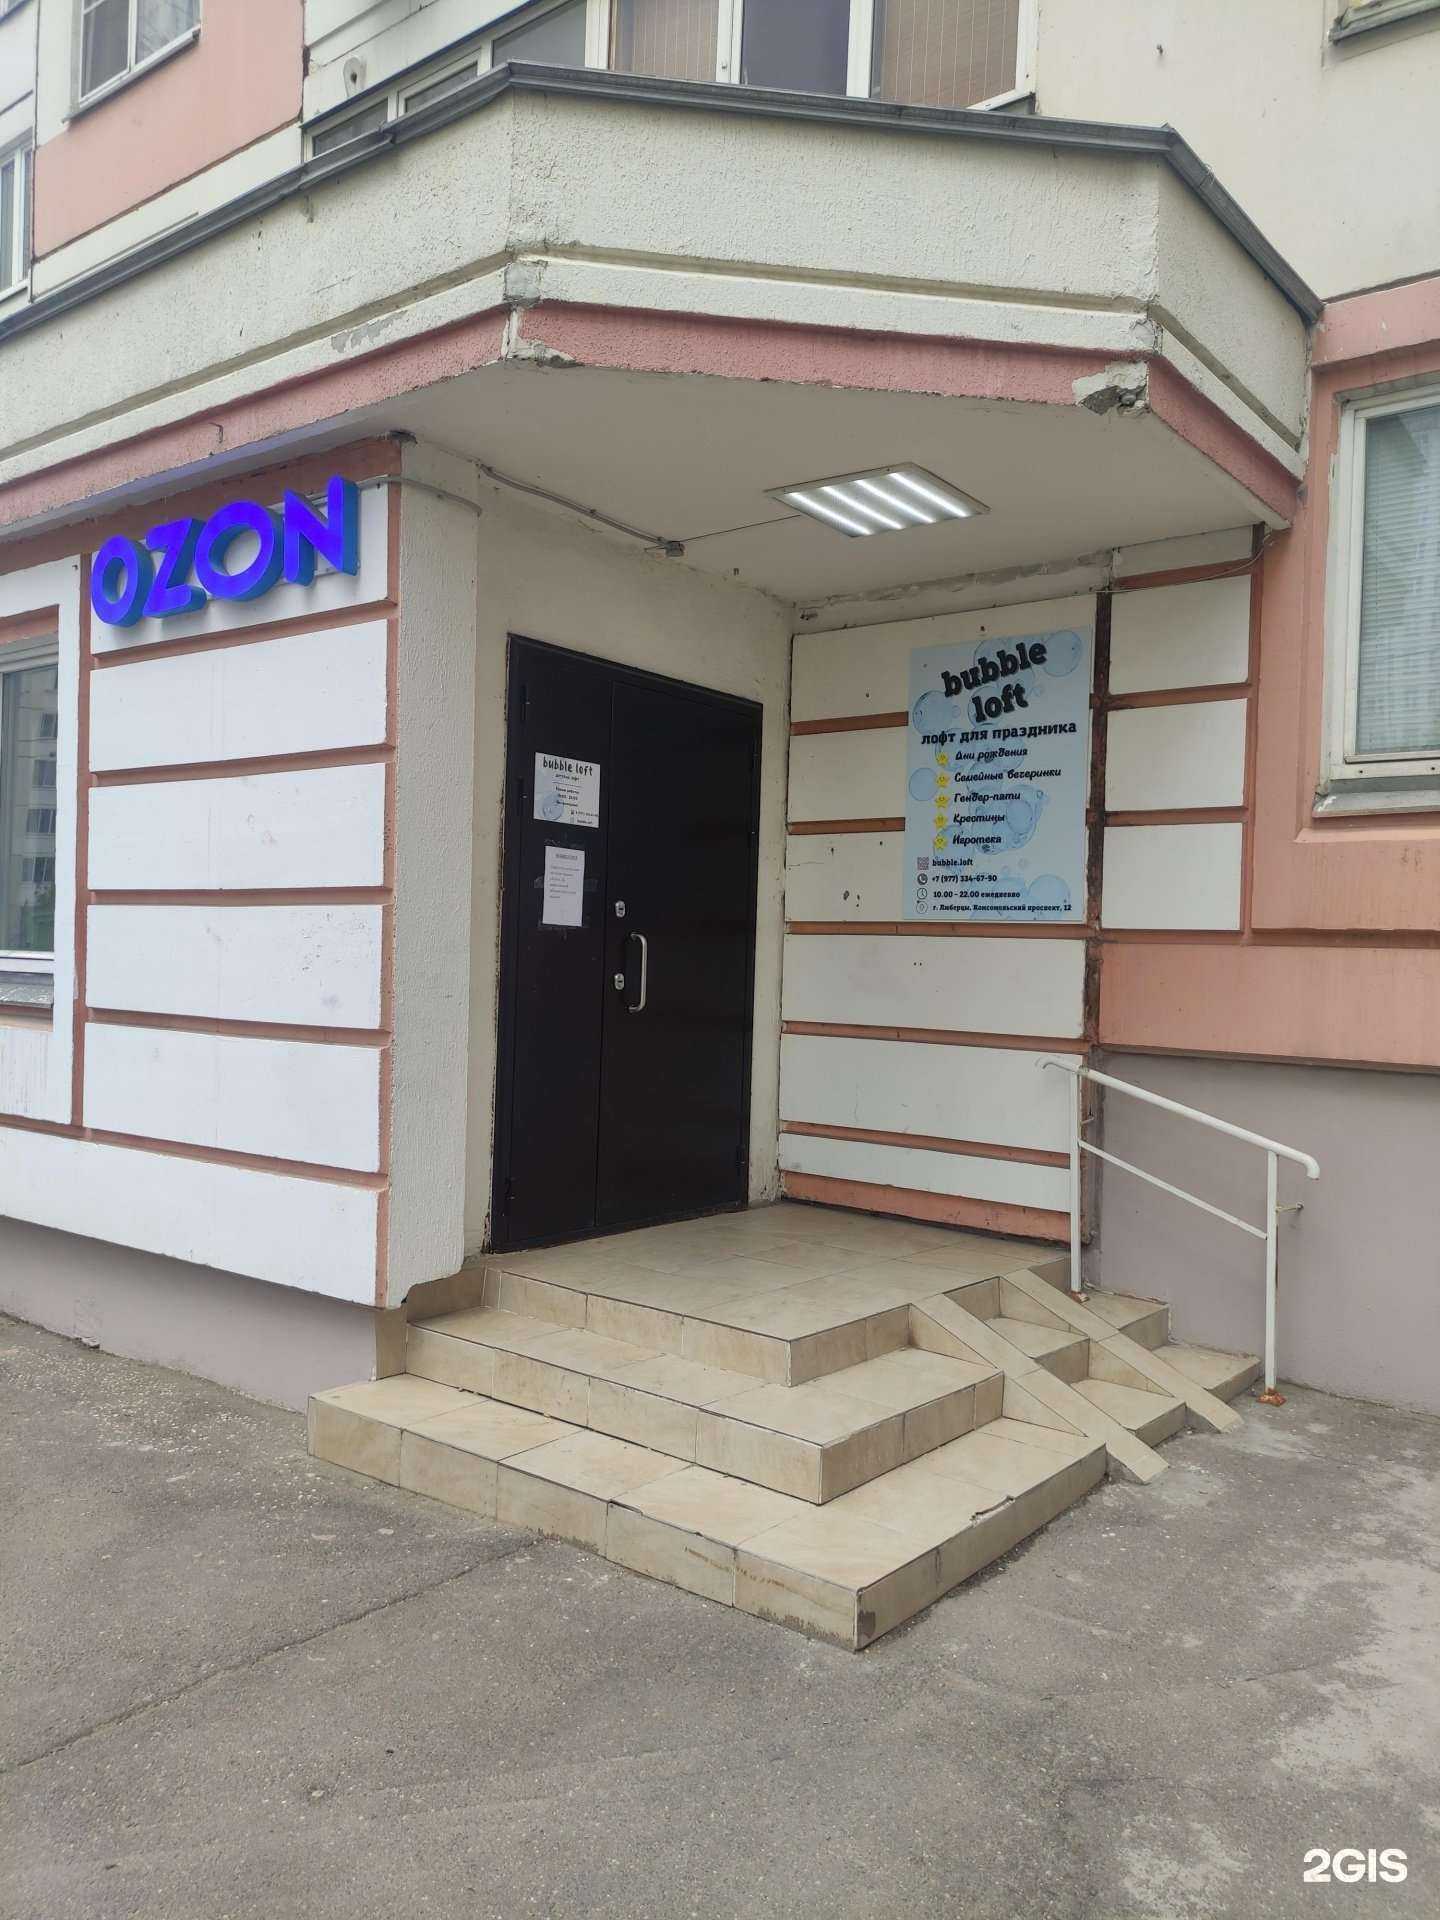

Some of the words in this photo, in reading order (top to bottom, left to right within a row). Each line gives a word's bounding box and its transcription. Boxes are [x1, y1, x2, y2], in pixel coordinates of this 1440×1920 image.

[80, 474, 360, 628] OZON
[941, 642, 1047, 697] bubble
[972, 683, 1029, 723] loft
[921, 730, 956, 746] лофт
[960, 729, 988, 744] для
[992, 722, 1077, 741] праздника
[977, 748, 1028, 763] рождения
[543, 756, 572, 773] bubble
[576, 764, 592, 776] loft
[954, 771, 1003, 782] Семейные
[1007, 769, 1062, 780] вечеринки
[953, 792, 1020, 804] Гендер-пати
[952, 834, 1002, 847] Игротека
[941, 875, 958, 883] (977)
